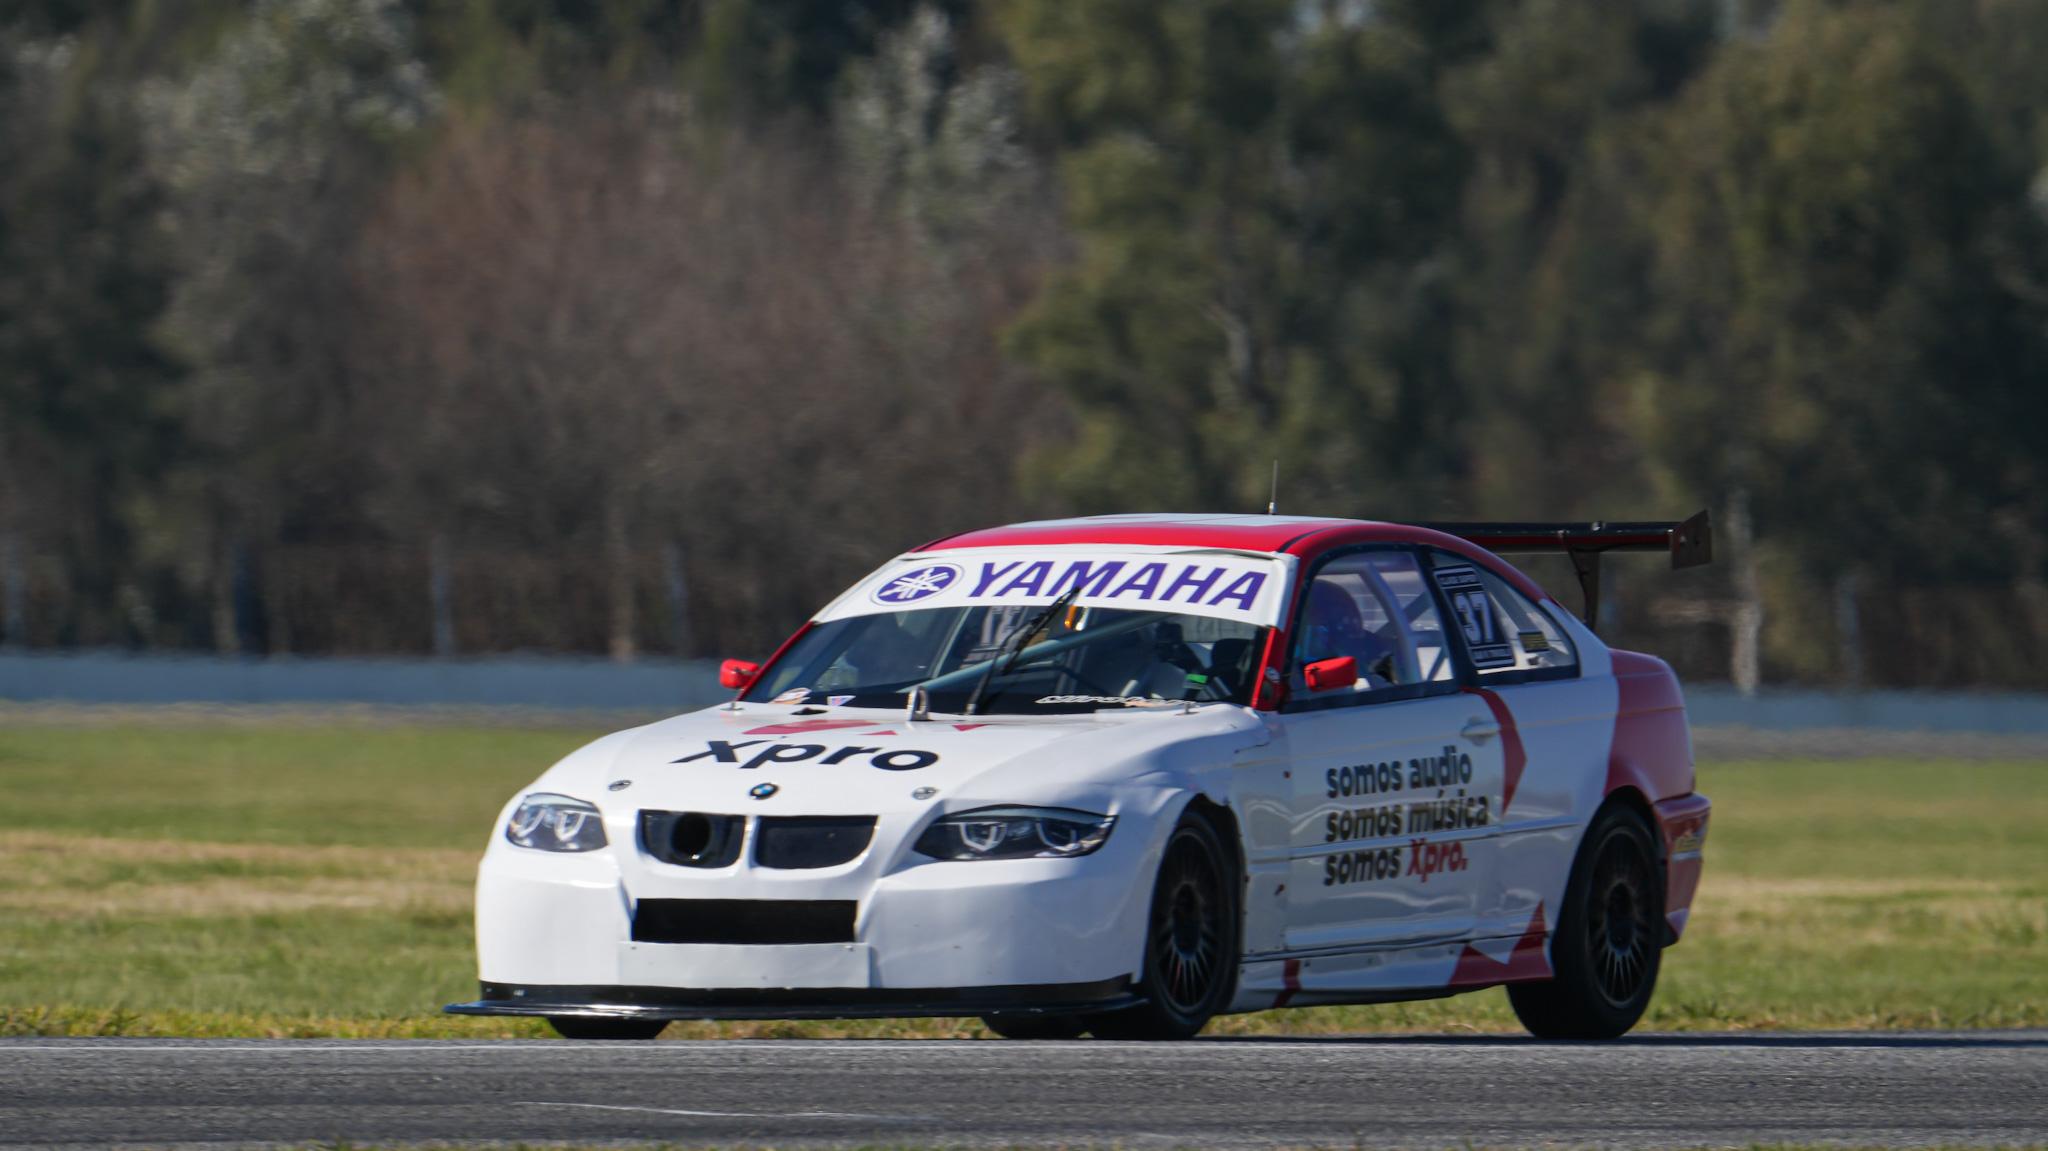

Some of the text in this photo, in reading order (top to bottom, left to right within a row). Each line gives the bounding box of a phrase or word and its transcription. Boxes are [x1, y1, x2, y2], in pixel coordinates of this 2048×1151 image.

[969, 560, 1268, 611] YAMAHA
[1455, 591, 1495, 644] 37
[669, 740, 939, 771] Xpro
[1326, 745, 1472, 798] somos audio
[1325, 788, 1489, 842] somos música
[1324, 848, 1401, 886] somos
